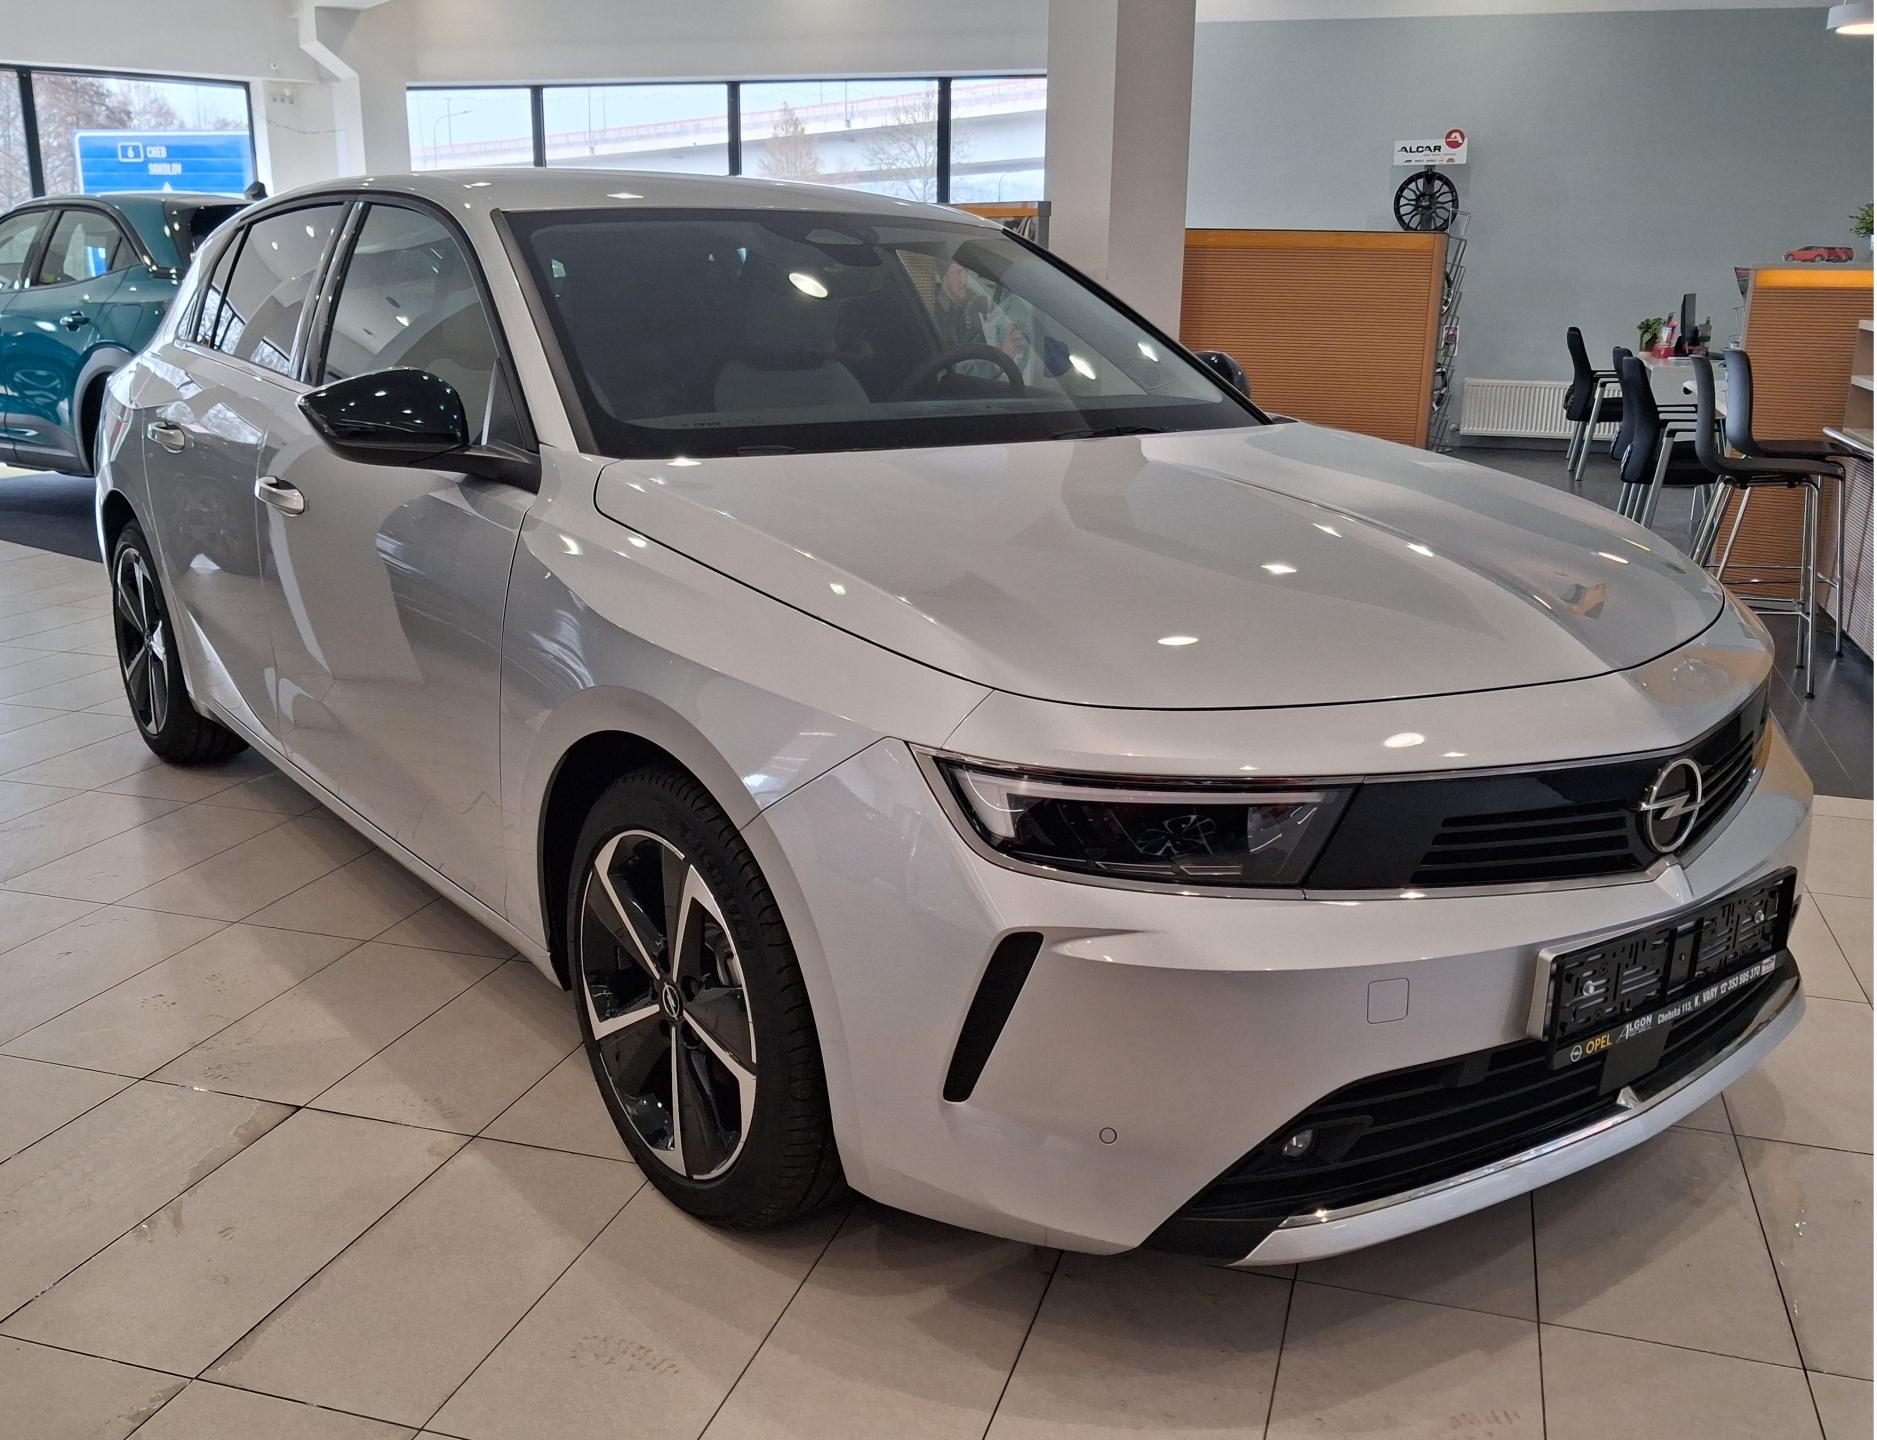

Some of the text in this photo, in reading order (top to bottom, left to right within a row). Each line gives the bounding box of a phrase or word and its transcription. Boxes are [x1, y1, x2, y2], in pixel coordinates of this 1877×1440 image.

[127, 146, 167, 158] 6 CHEB
[1398, 145, 1442, 153] ALCAR
[1694, 995, 1701, 1007] K.
[1703, 986, 1719, 1003] VARY
[1616, 1014, 1652, 1043] ALGON
[1586, 1034, 1612, 1054] OPEL
